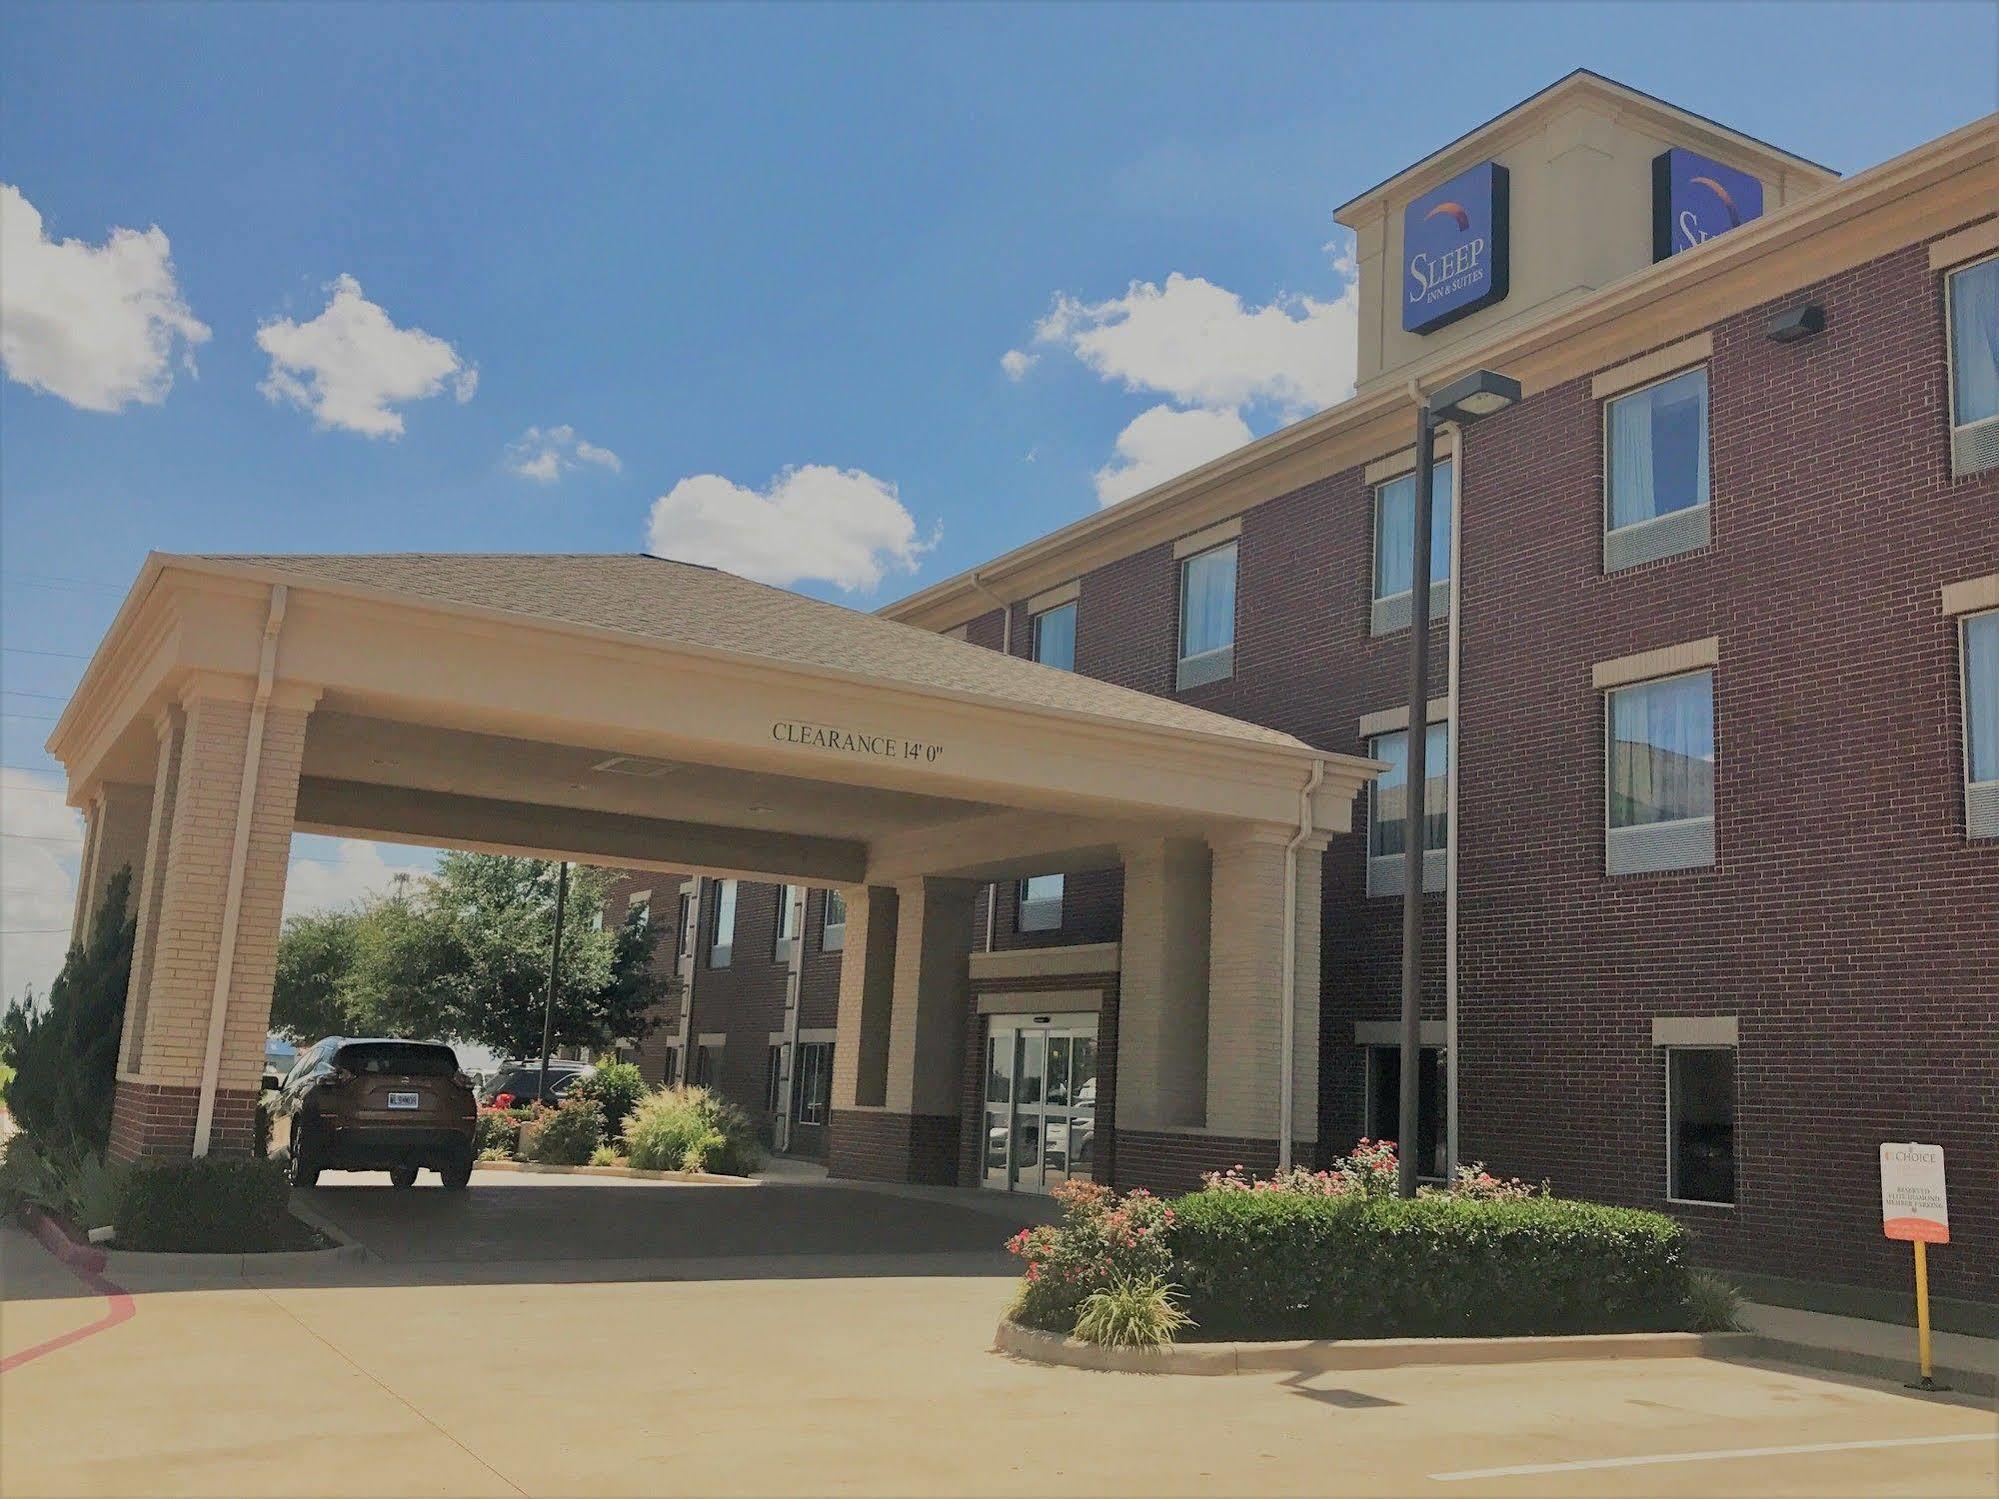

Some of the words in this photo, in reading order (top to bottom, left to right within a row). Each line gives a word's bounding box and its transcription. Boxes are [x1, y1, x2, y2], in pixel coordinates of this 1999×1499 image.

[1410, 238, 1484, 302] SLEEP
[772, 722, 897, 757] CLEARANCE
[1895, 1151, 1937, 1163] CHOICE
